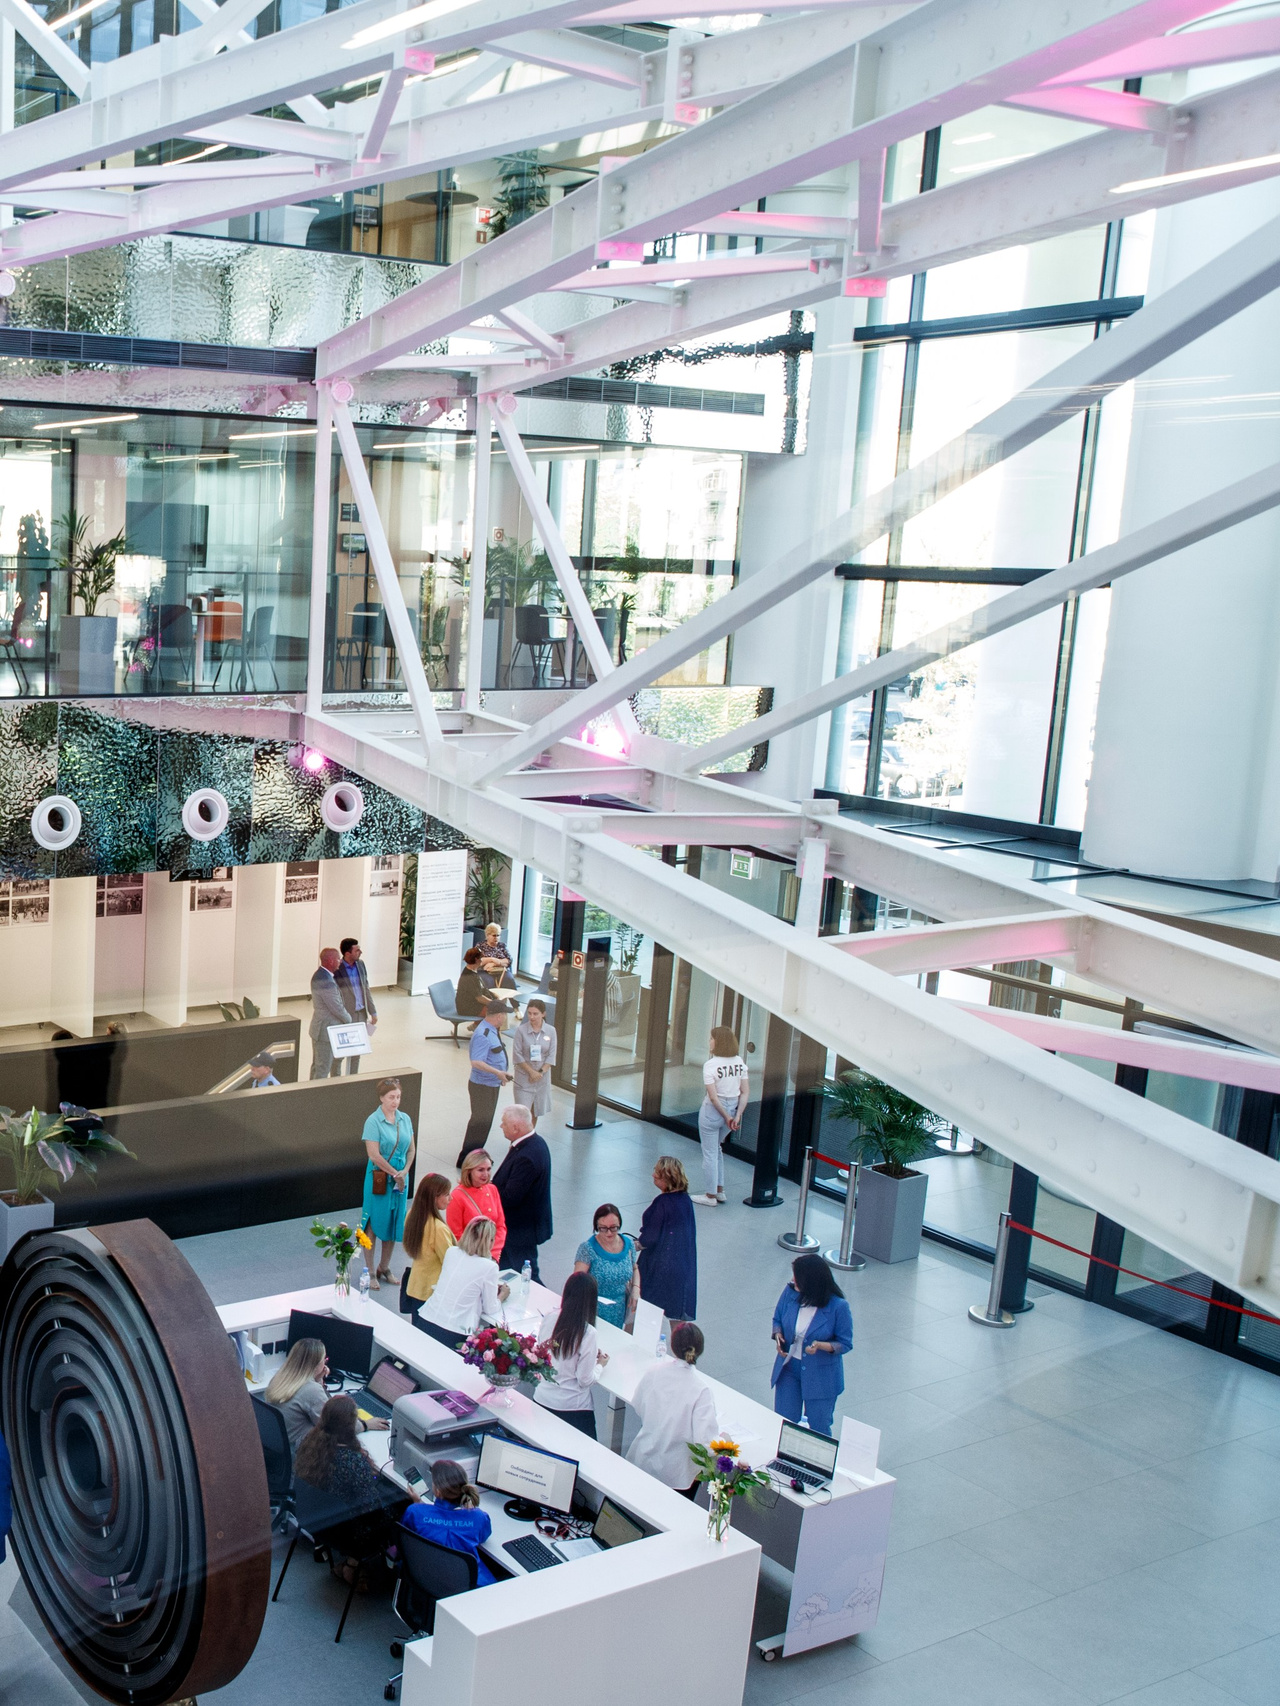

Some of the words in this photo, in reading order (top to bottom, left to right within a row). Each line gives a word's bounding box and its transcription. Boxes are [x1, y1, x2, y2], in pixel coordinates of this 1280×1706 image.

[717, 1064, 743, 1079] STAFF
[423, 1516, 453, 1527] CAMPUS
[454, 1520, 474, 1528] TEAM
